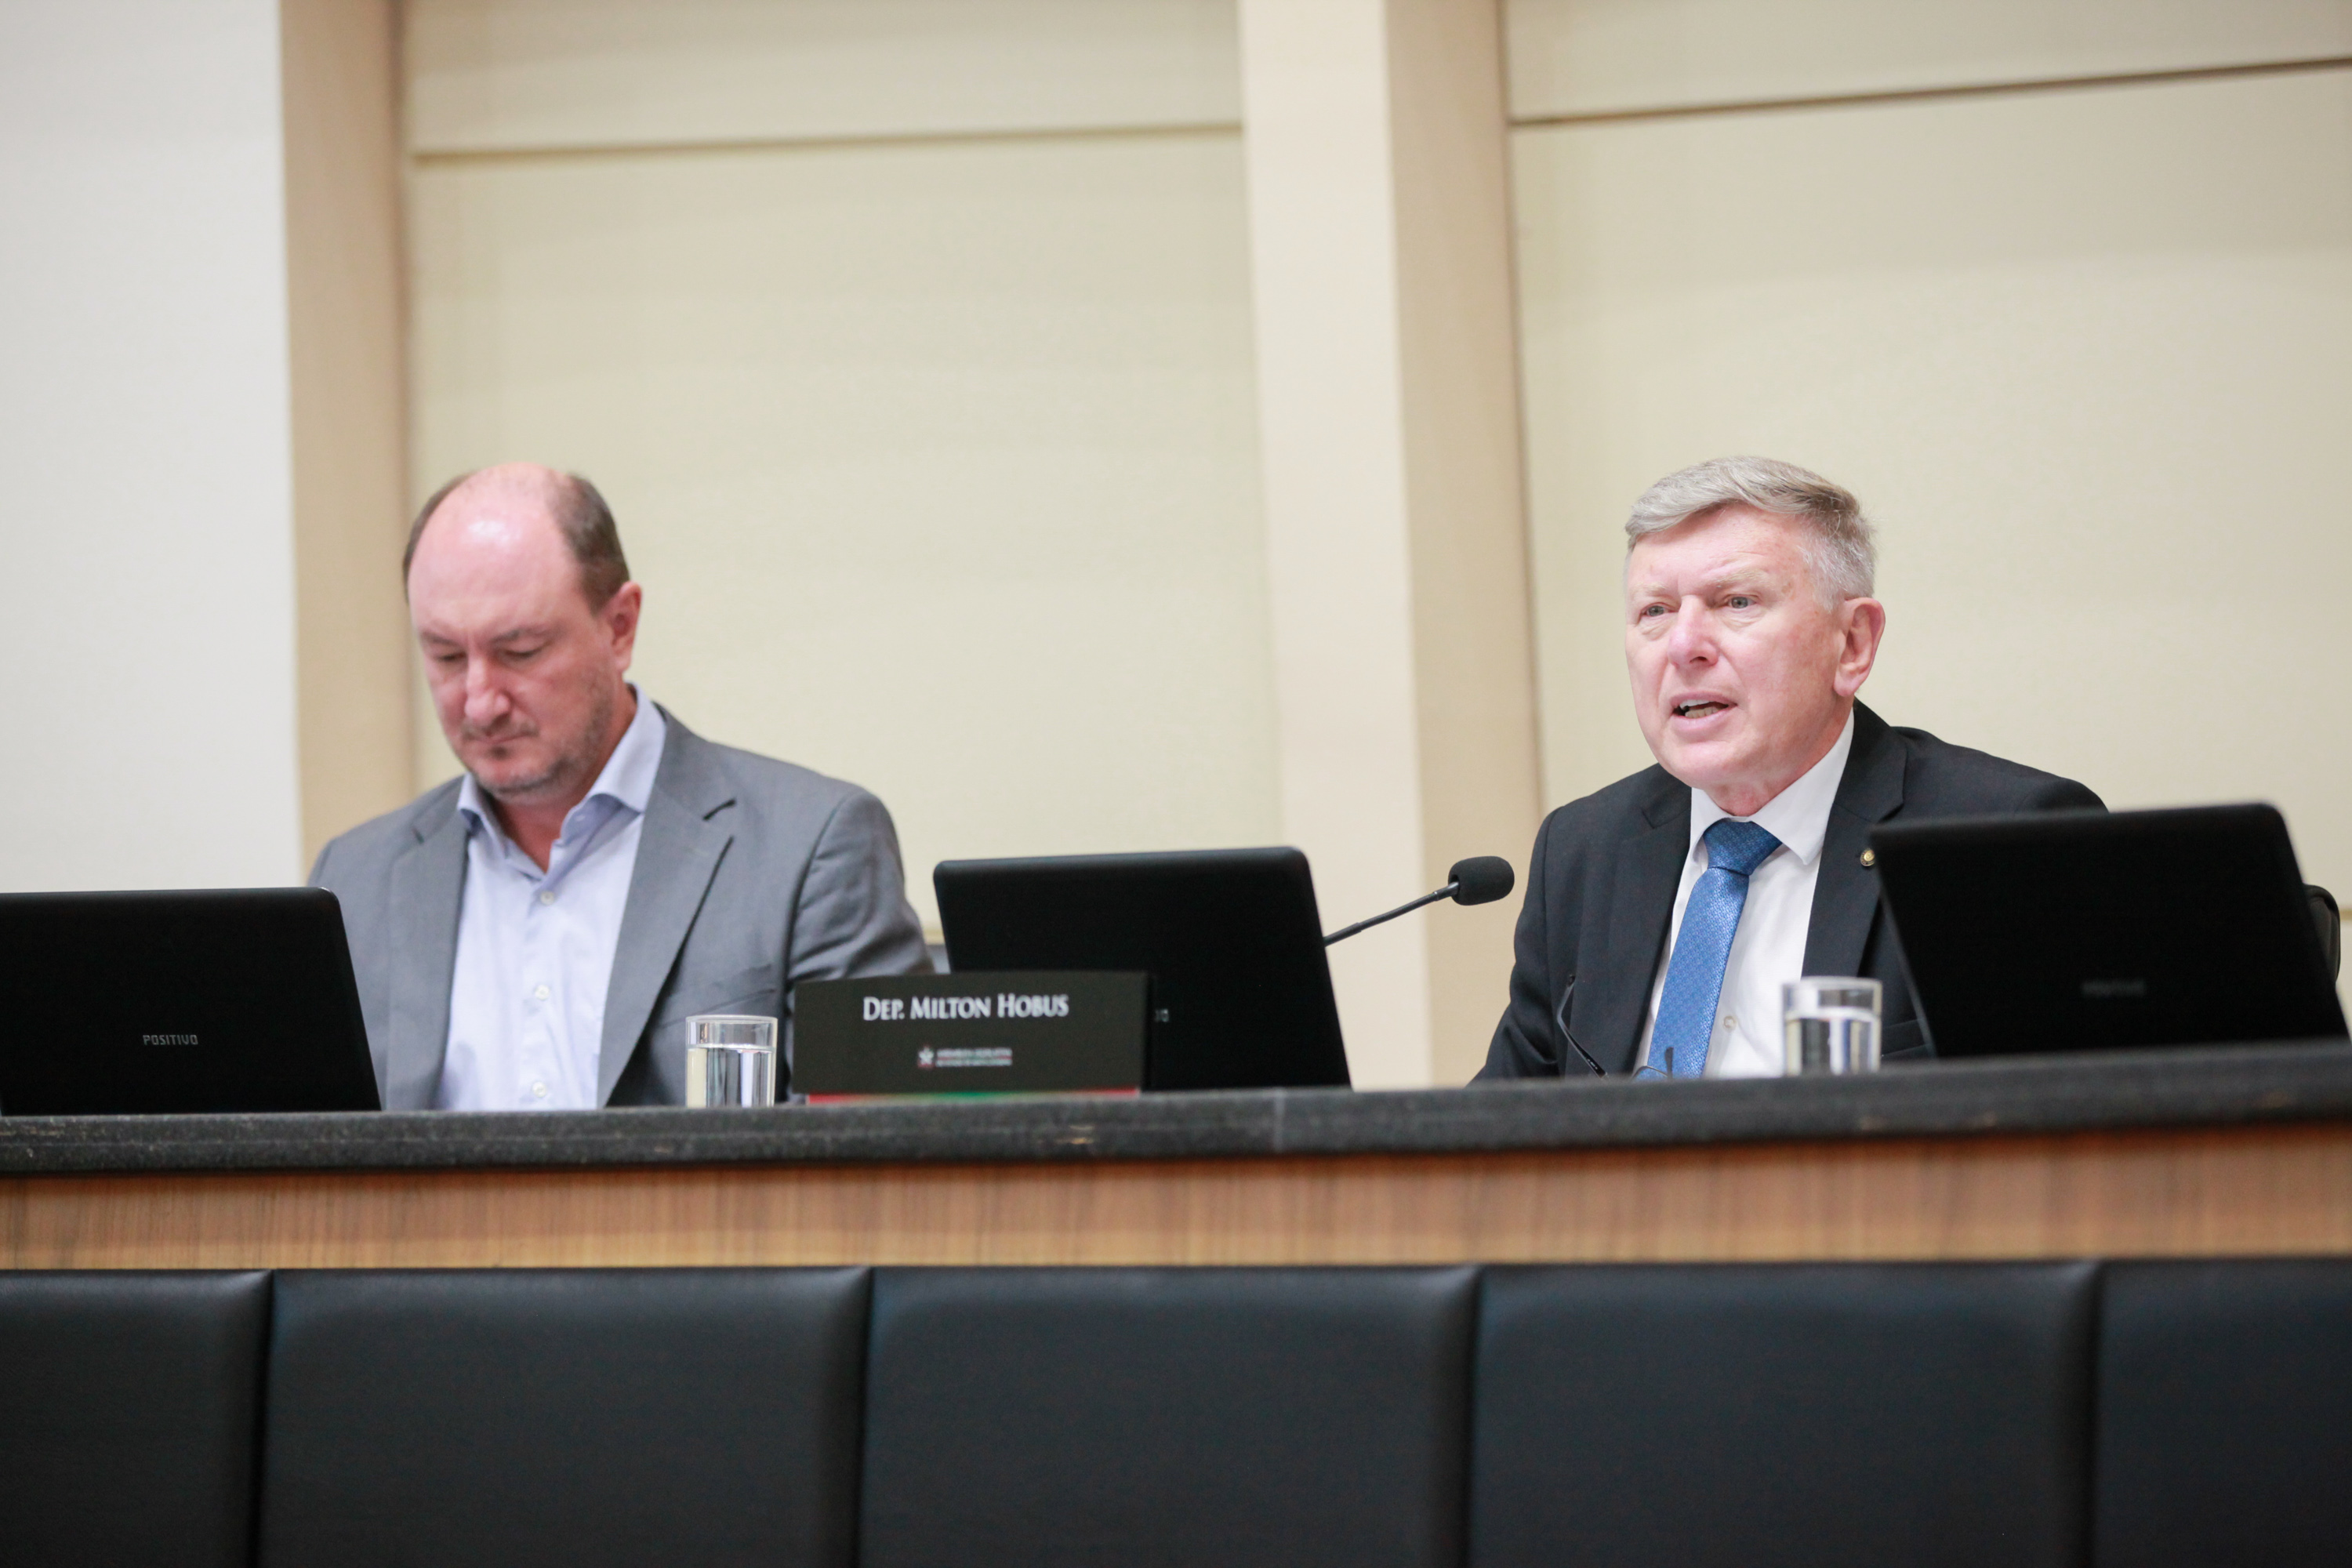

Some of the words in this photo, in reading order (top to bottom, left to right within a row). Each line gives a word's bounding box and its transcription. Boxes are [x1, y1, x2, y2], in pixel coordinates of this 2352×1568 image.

[863, 996, 905, 1021] DEP.
[910, 996, 992, 1019] MILTON
[997, 993, 1069, 1018] HOBUS
[143, 1034, 198, 1045] POSITIVO
